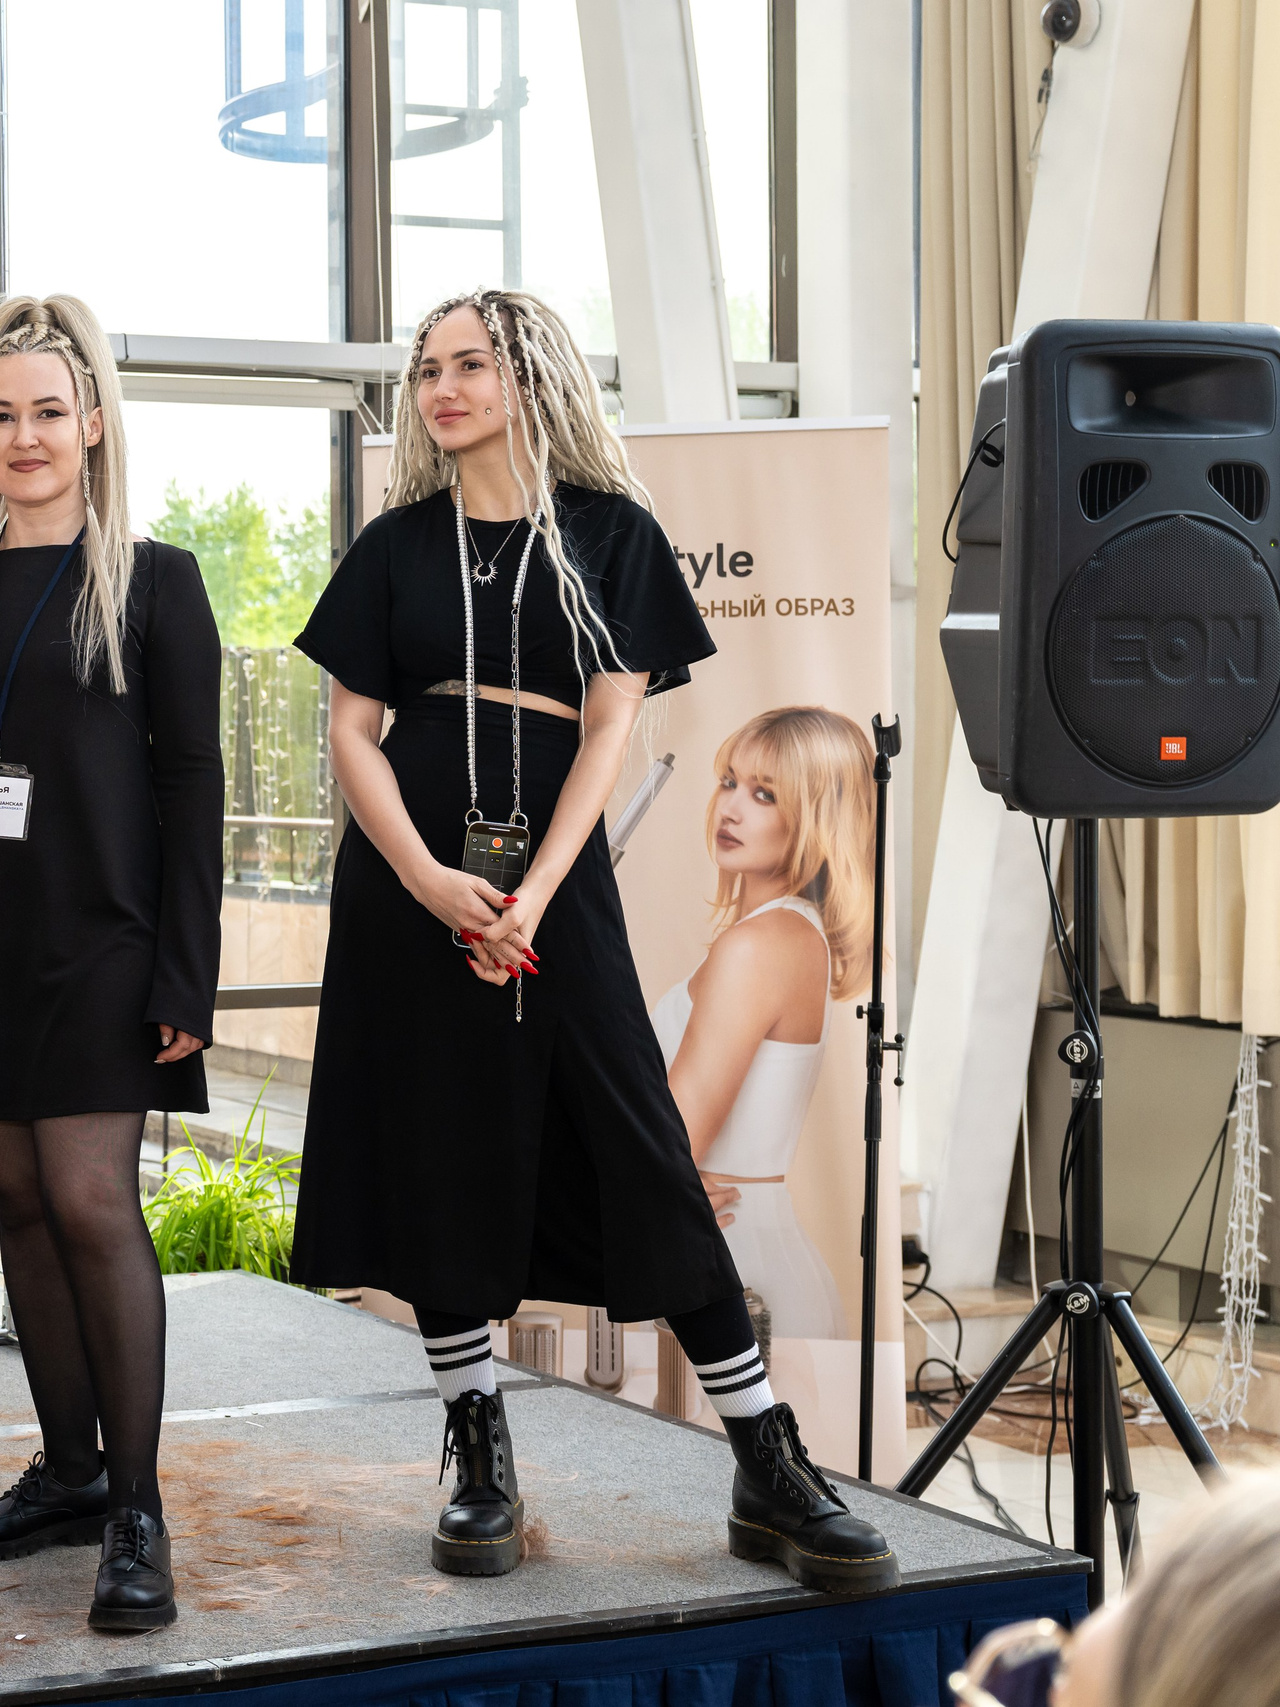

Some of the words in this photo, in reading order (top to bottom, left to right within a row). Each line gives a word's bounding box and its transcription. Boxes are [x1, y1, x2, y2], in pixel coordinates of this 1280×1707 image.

[775, 597, 855, 617] ОБРАЗ
[1089, 612, 1262, 686] EON
[1165, 742, 1184, 754] JBL
[1072, 1038, 1082, 1064] K&M
[1066, 1294, 1091, 1312] K&M
